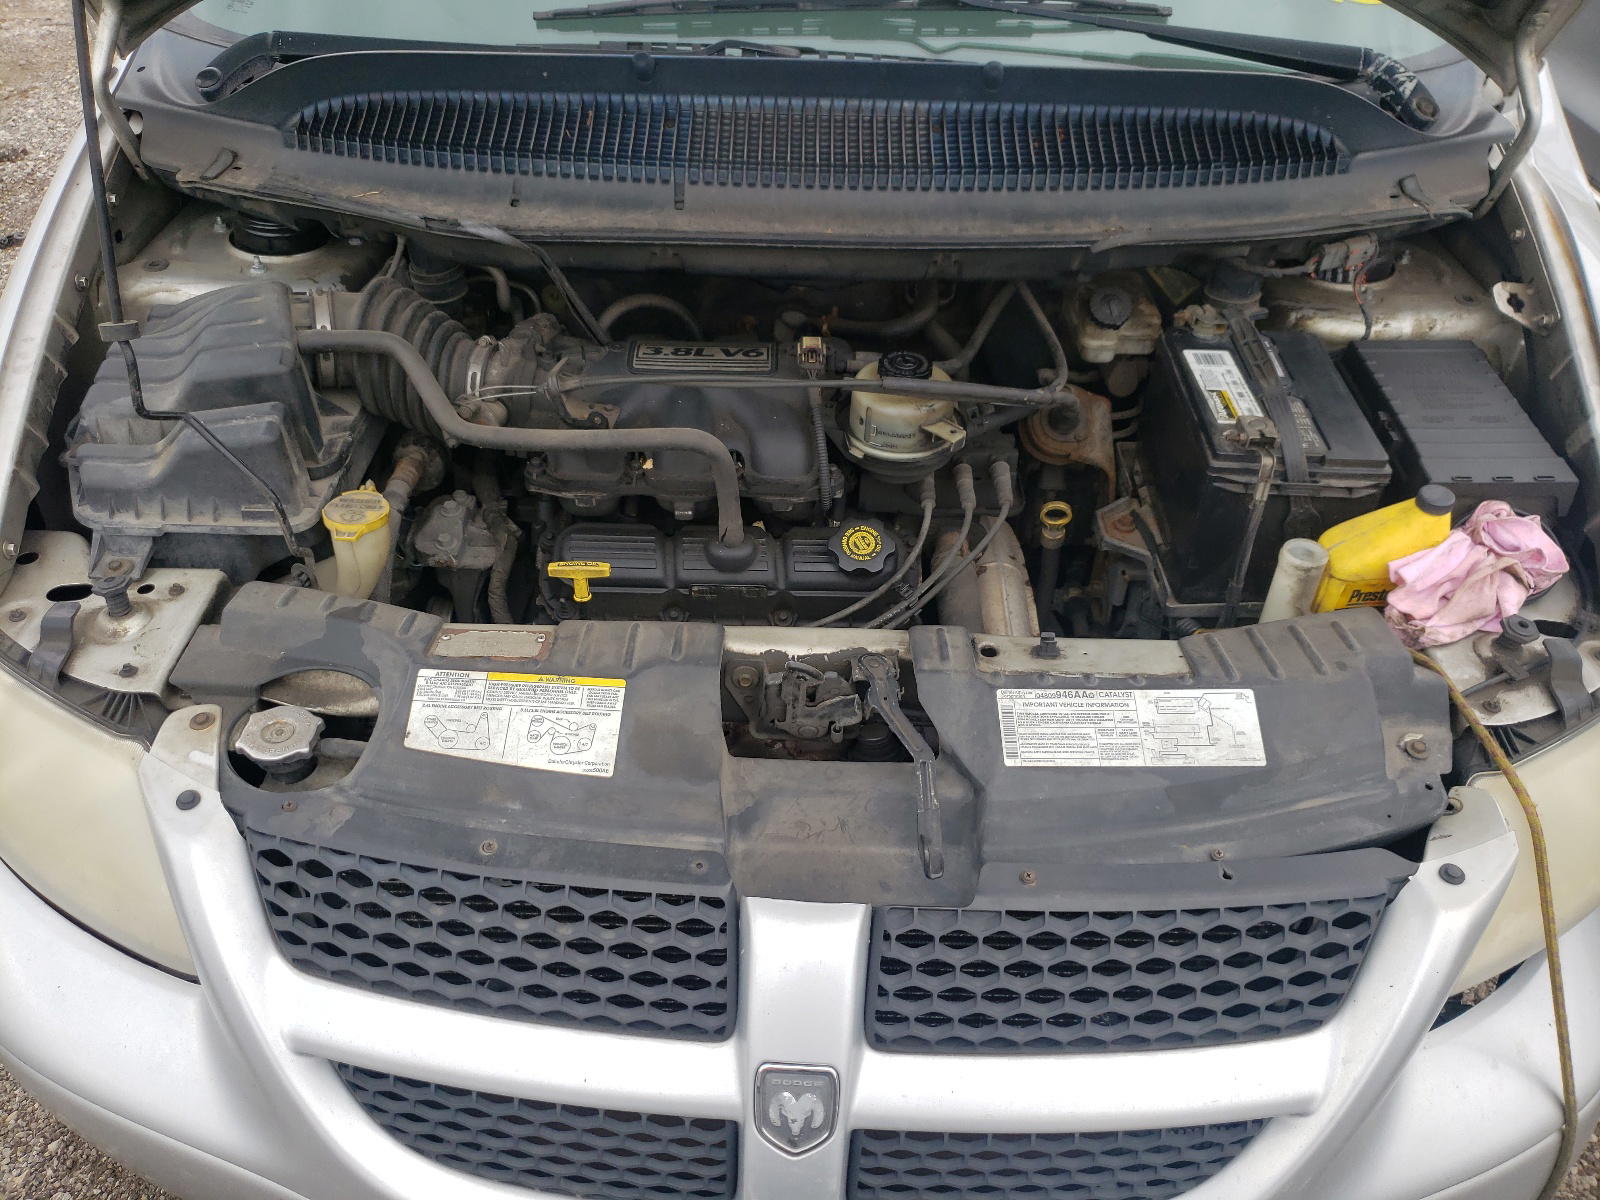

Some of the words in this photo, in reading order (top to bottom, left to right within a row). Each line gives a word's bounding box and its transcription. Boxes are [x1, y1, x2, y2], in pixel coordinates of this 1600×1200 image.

[642, 346, 714, 357] 3.8L
[720, 348, 764, 357] V6
[545, 676, 576, 684] WARNING
